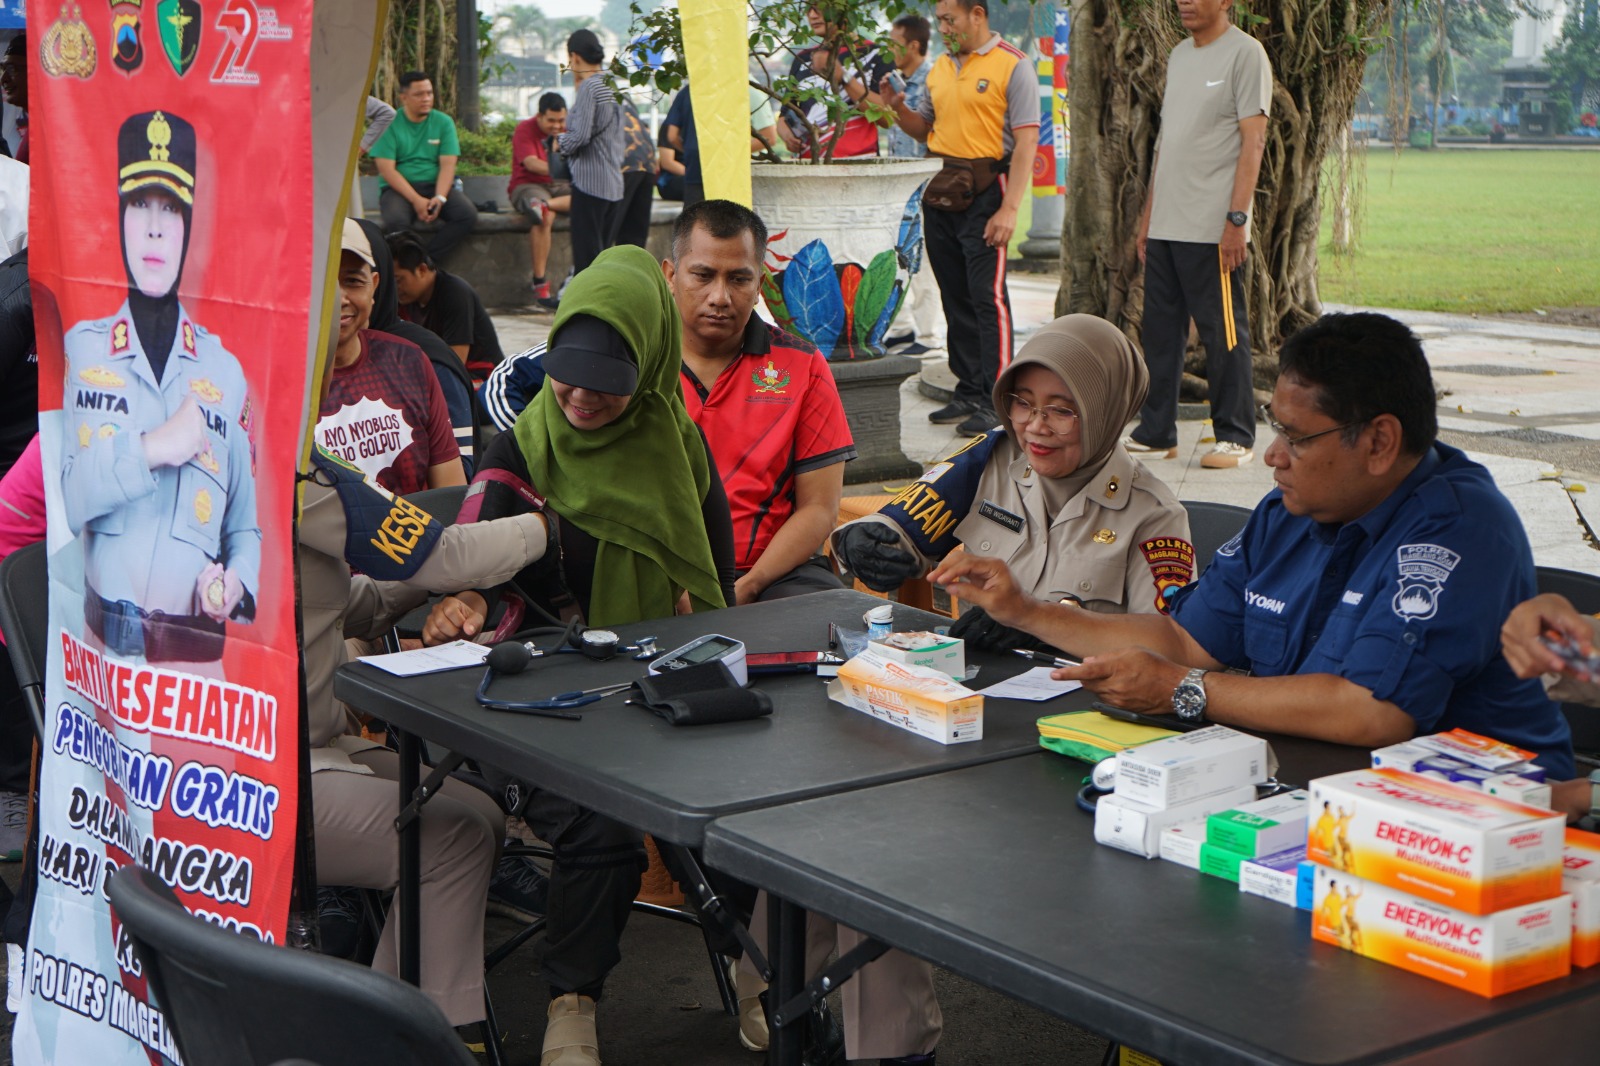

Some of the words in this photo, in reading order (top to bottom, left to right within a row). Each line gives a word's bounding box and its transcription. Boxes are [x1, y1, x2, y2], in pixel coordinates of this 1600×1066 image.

[76, 389, 129, 415] ANITA
[199, 405, 227, 440] LRI
[324, 426, 347, 448] AYO
[348, 413, 400, 443] NYOBLOS
[359, 431, 402, 459] GOLPUT
[984, 505, 993, 514] TRI
[1146, 538, 1193, 554] POLRES
[1149, 550, 1179, 560] MAGELANG
[1407, 546, 1450, 558] POLRES
[60, 631, 106, 706] BAKTI
[104, 661, 274, 757] KESEHATAN
[174, 765, 276, 837] GRATIS
[69, 786, 134, 855] DALAM
[1375, 820, 1473, 864] ENERVON-C
[40, 833, 99, 889] HARI
[1396, 848, 1473, 880] Multivitamin
[1384, 901, 1483, 946] ENERVON-C
[1405, 928, 1483, 961] Multivitamin
[31, 950, 107, 1020] POLRES
[110, 982, 184, 1066] MAGELA
